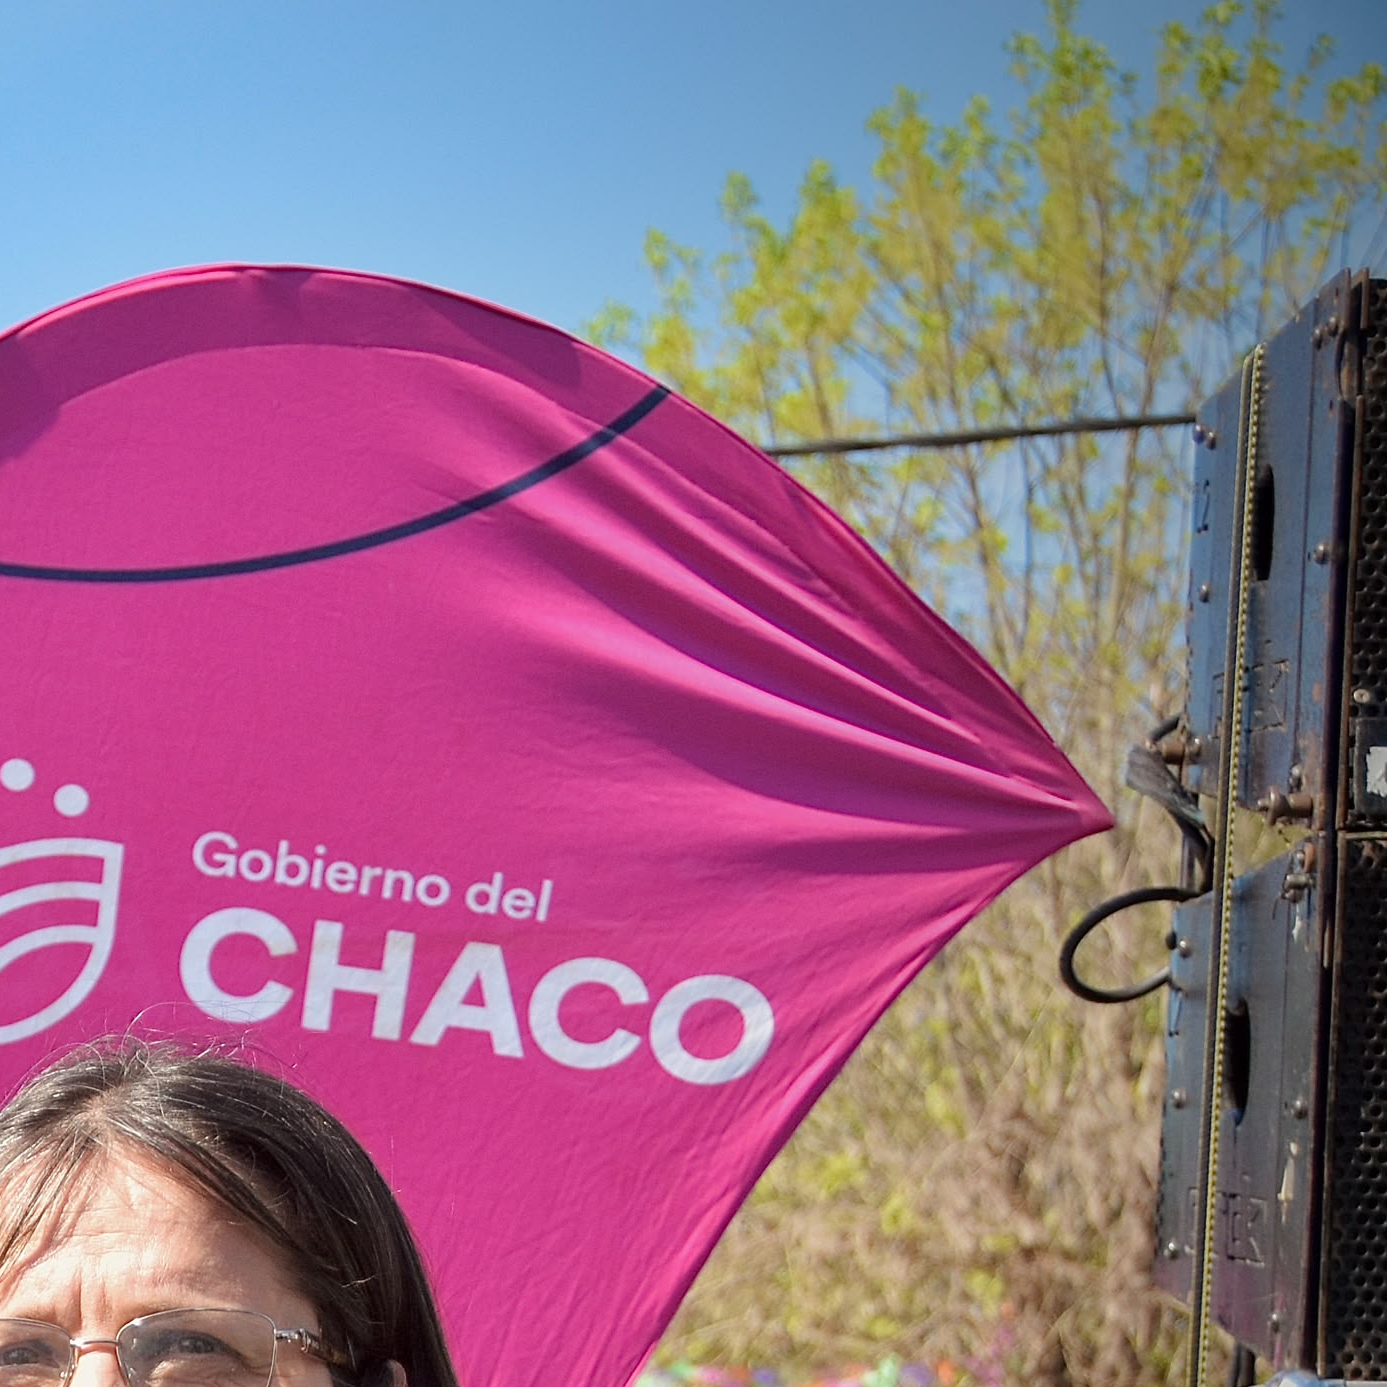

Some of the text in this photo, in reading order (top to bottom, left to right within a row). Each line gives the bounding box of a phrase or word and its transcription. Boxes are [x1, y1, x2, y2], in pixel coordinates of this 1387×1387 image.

[191, 830, 553, 922] Gobierno del
[178, 906, 775, 1085] CHACO
